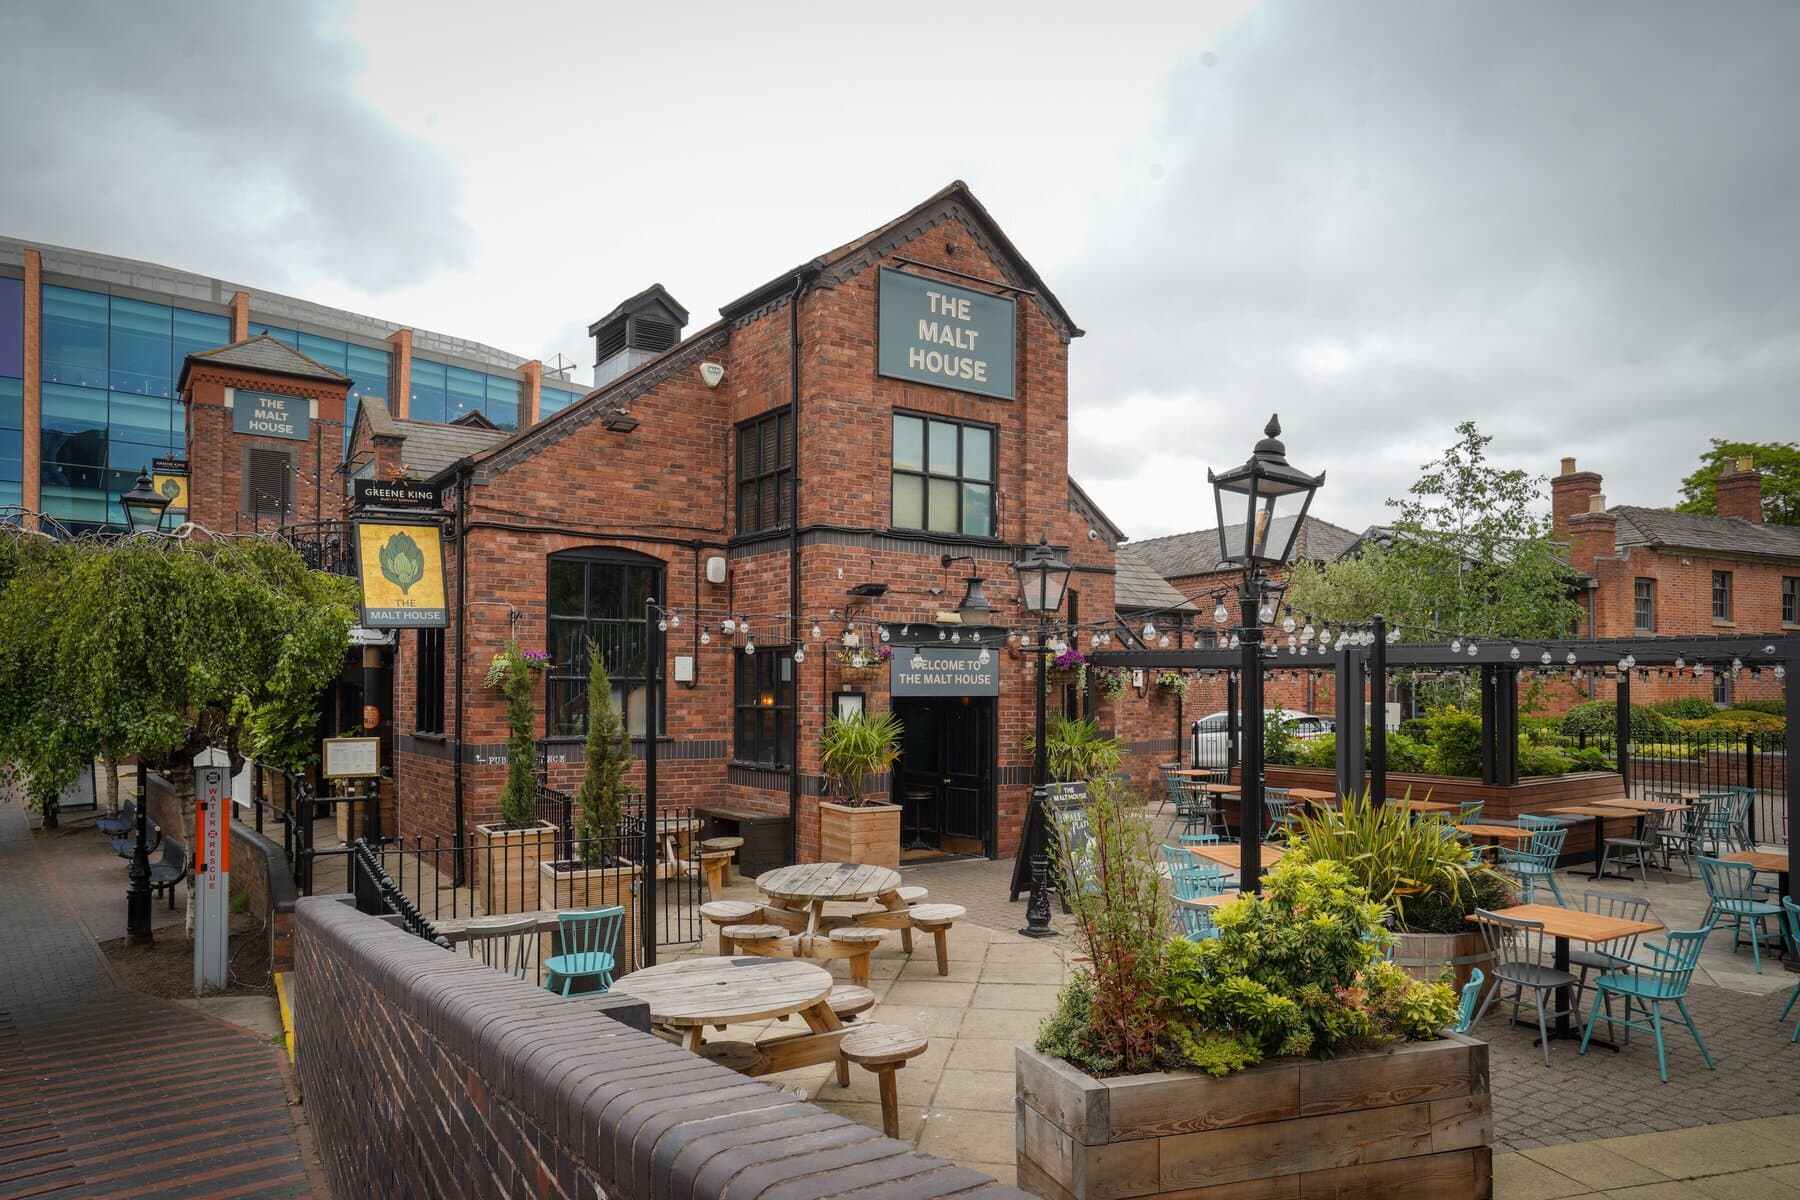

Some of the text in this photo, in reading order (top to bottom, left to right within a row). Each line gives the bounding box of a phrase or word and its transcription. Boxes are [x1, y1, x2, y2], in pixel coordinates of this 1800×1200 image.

[926, 291, 971, 321] THE
[919, 319, 979, 351] MALT
[909, 346, 987, 382] HOUSE
[259, 398, 285, 410] THE
[254, 409, 289, 422] MALT
[249, 420, 294, 434] HOUSE
[365, 488, 405, 498] GREENE
[408, 491, 433, 500] KING
[395, 599, 417, 607] THE
[370, 611, 441, 620] MALT HOUSE
[910, 659, 981, 671] WELCOME TO
[899, 673, 991, 685] THE MALT HOUSE
[1063, 786, 1075, 794] THE
[209, 788, 217, 826] WATER
